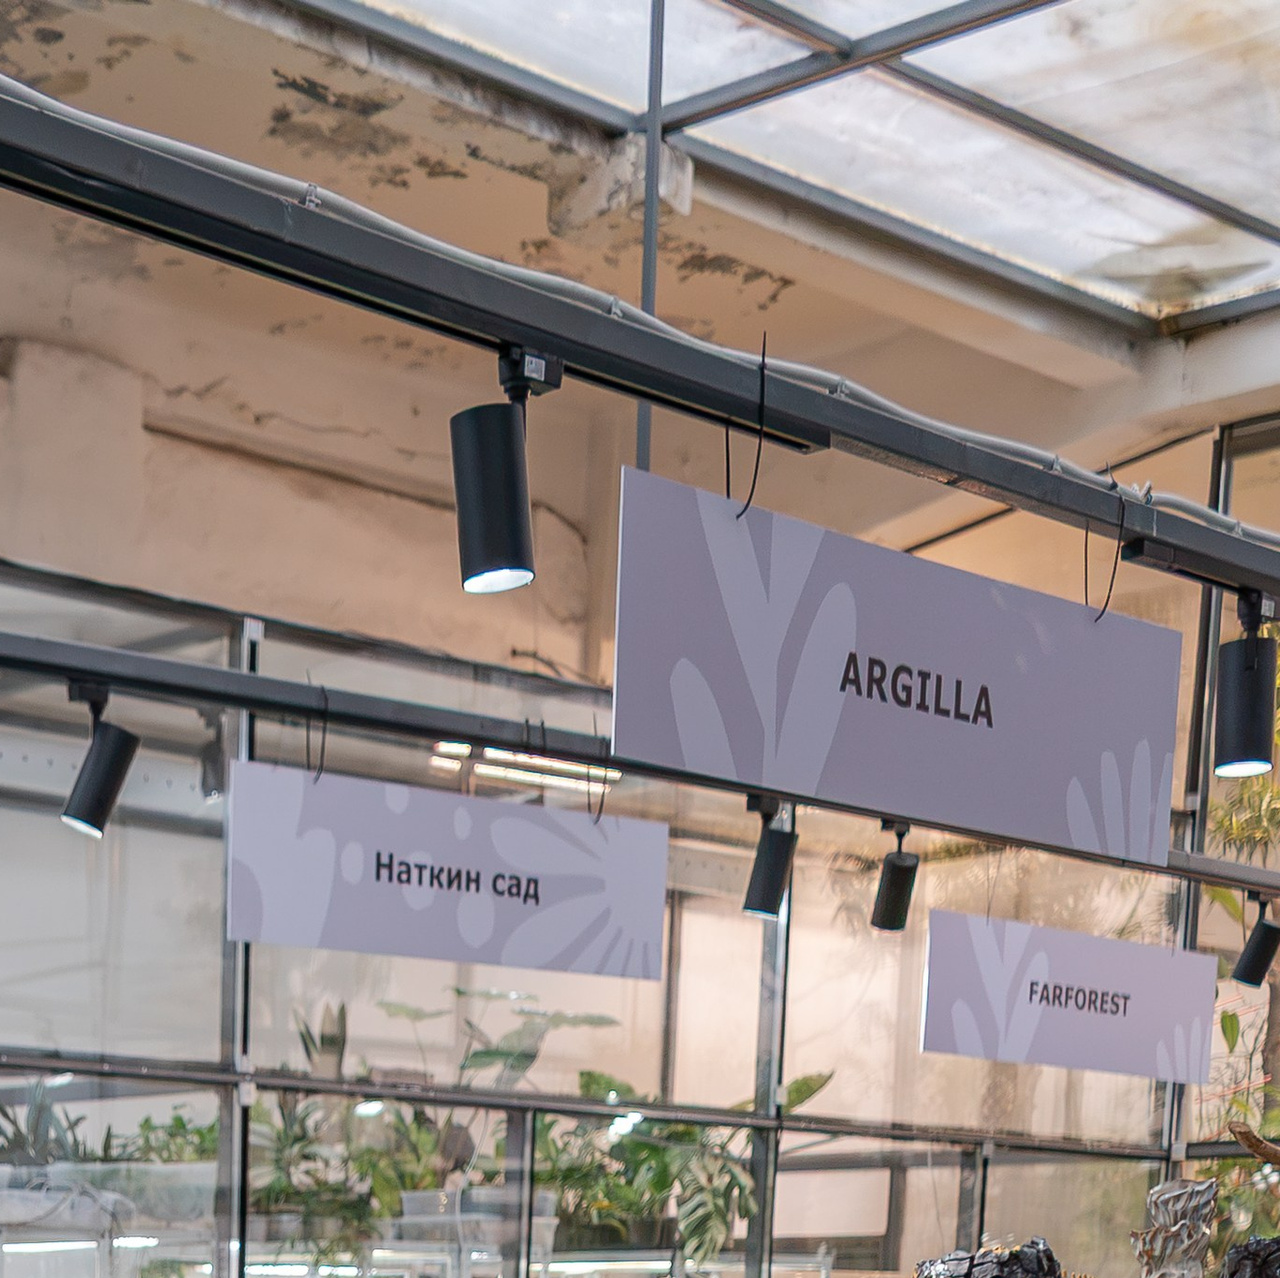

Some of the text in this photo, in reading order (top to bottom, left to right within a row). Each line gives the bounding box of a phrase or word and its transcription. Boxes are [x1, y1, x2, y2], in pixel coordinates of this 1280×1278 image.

[839, 651, 994, 729] ARGILLA
[375, 851, 540, 906] Наткин сад
[1028, 980, 1131, 1018] FARFOREST
